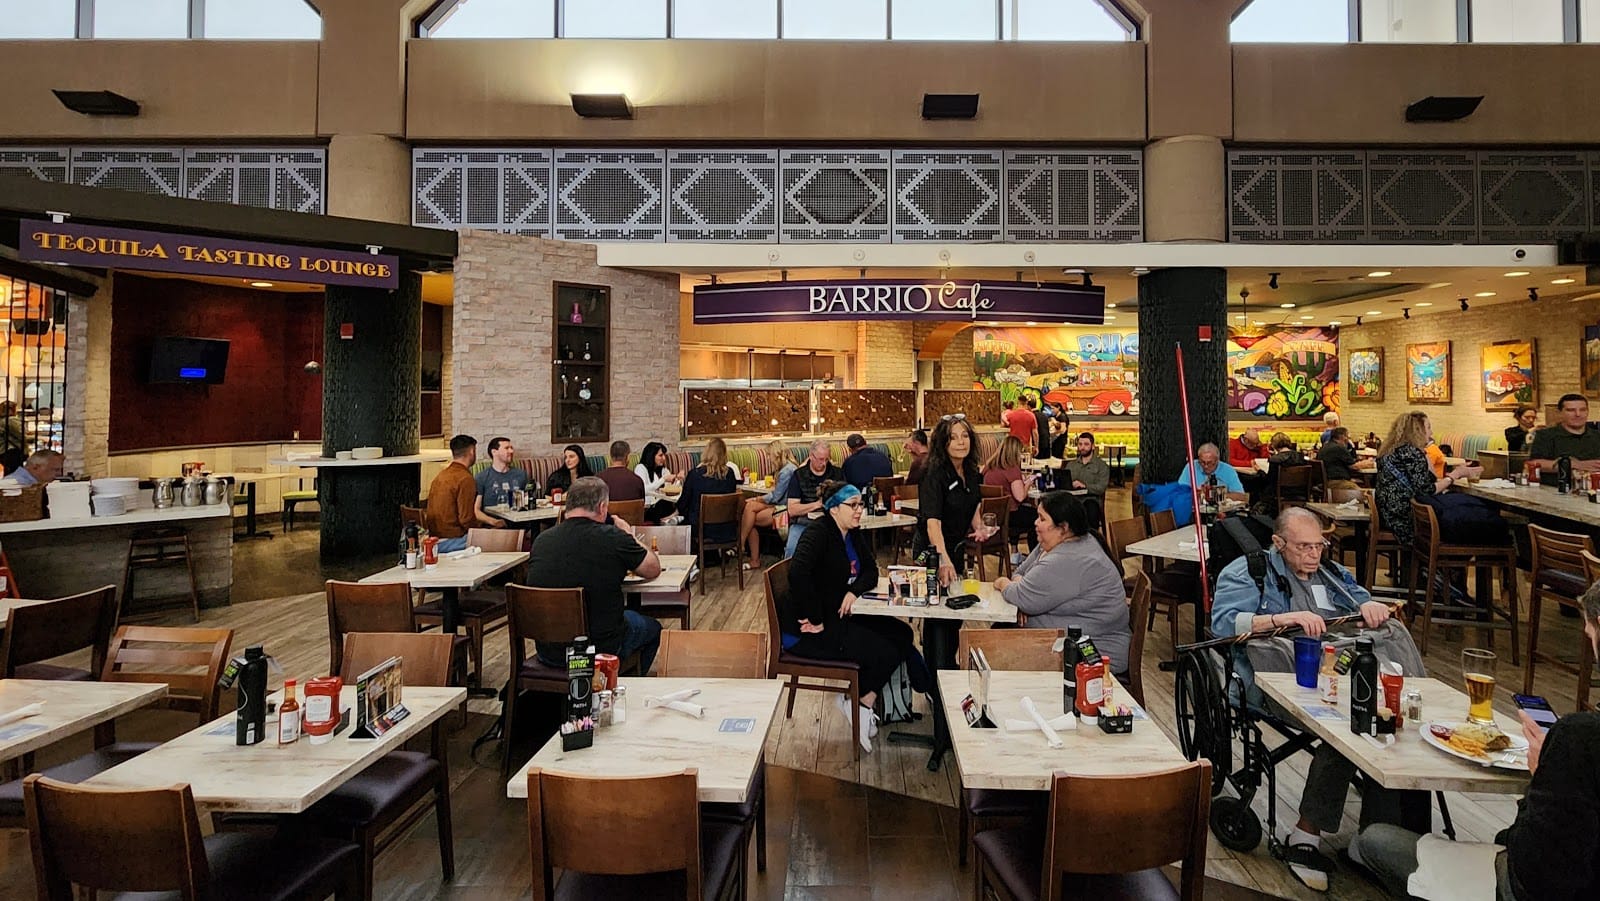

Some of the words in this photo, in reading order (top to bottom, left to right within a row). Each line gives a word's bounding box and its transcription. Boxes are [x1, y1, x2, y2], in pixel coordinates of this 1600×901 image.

[32, 232, 169, 259] TEQUILA
[178, 245, 291, 270] TASTING
[299, 256, 391, 278] LOUNGE
[809, 285, 932, 313] BARRIO
[938, 281, 995, 318] Cafe
